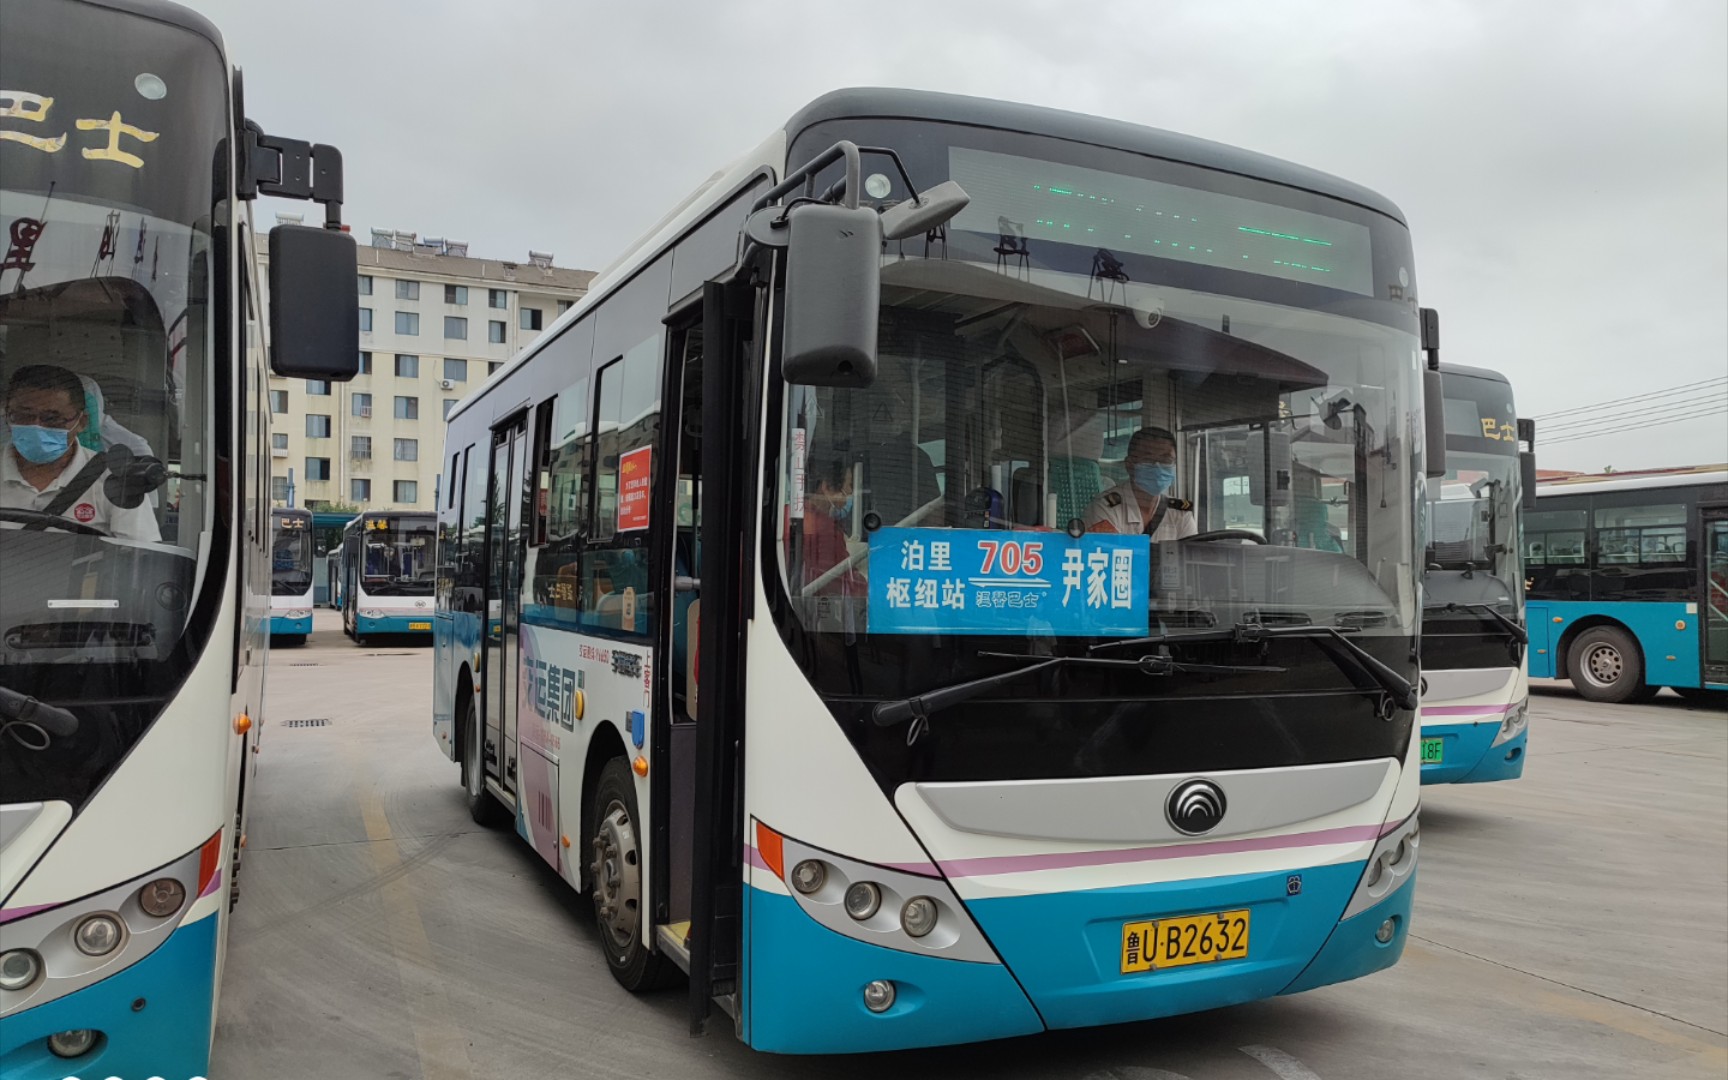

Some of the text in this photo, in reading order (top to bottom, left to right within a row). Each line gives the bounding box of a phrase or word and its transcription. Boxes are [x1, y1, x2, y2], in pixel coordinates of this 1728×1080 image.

[1481, 417, 1515, 442] 巴士
[281, 517, 305, 529] 巴士
[900, 540, 953, 571] 泊里
[977, 540, 1044, 576] 705
[886, 577, 966, 609] 枢纽站
[1061, 547, 1134, 610] 尹家圈
